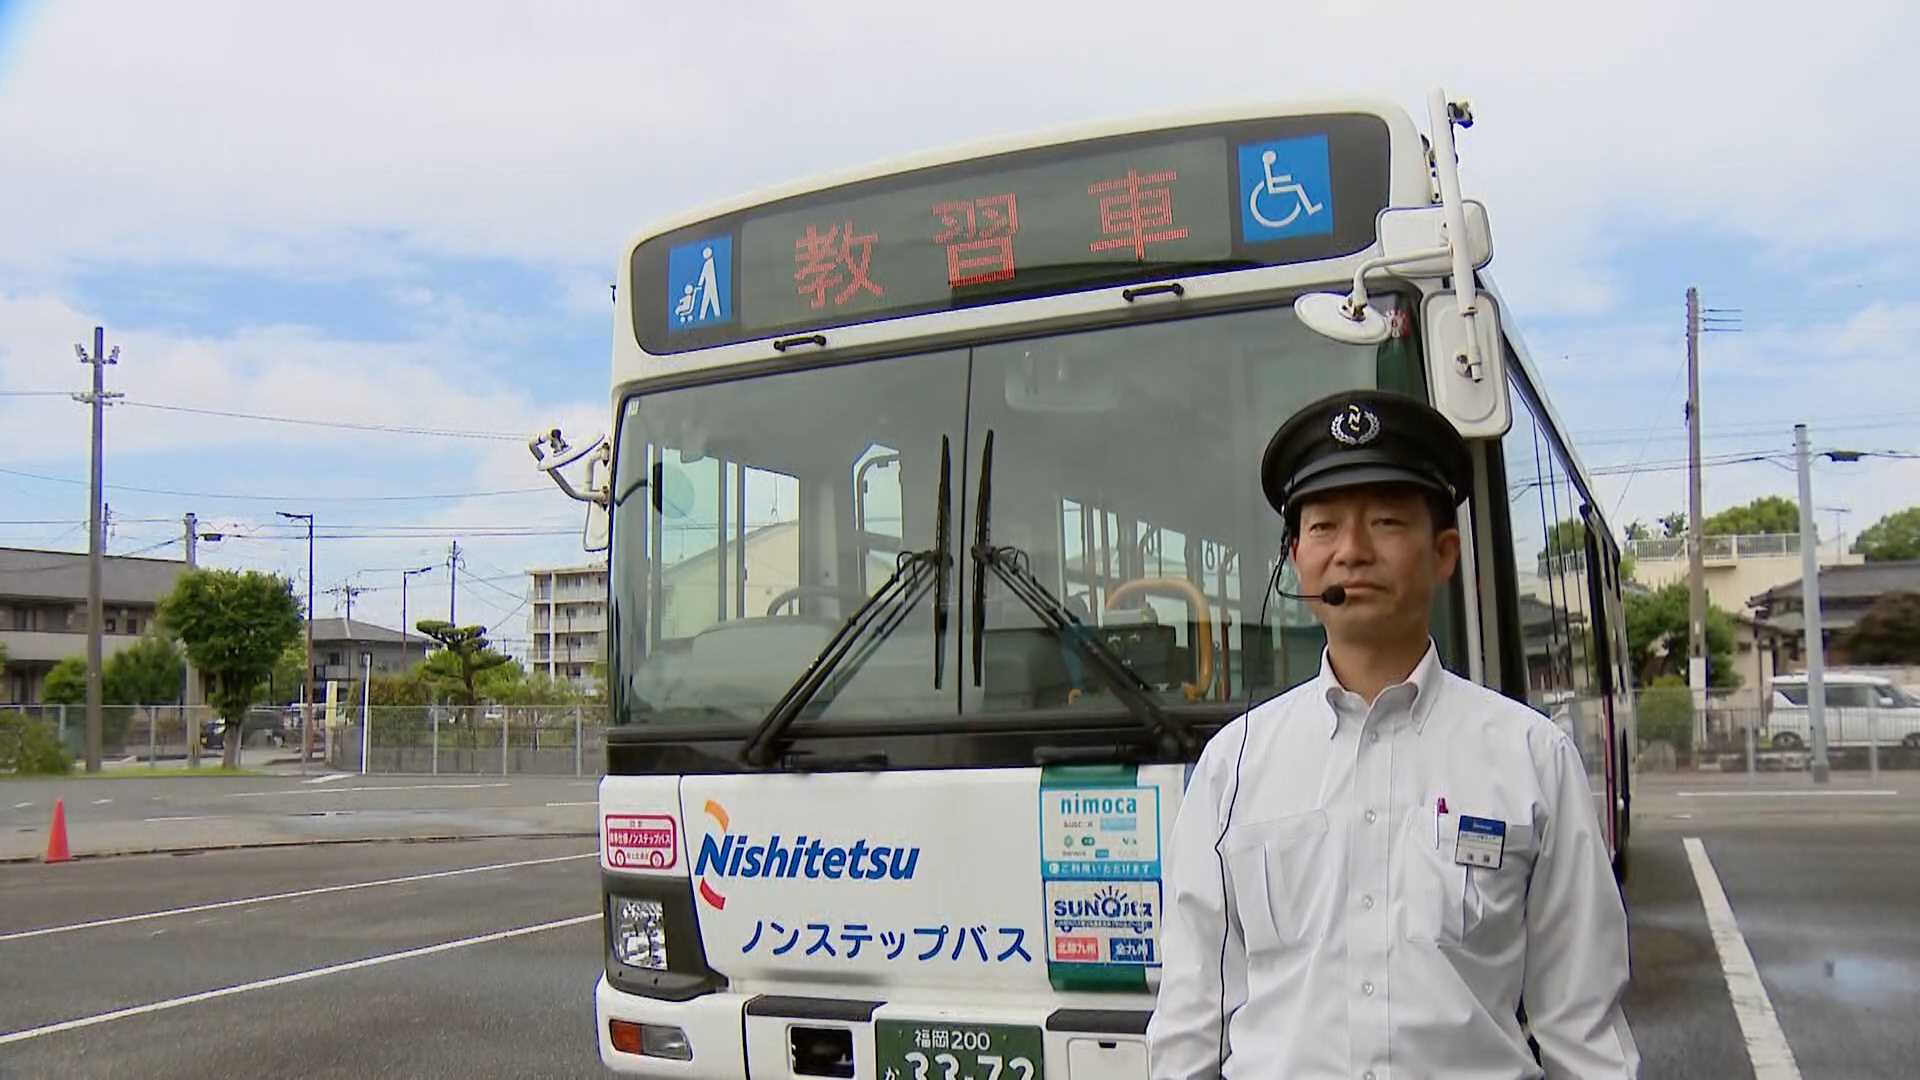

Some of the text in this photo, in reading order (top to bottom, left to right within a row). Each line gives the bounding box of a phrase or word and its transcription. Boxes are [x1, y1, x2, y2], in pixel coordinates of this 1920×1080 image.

[795, 168, 1190, 309] 教習車
[1061, 793, 1136, 814] nimoca
[694, 833, 920, 880] Nishitetsu
[742, 920, 1032, 962] ノンステップバス
